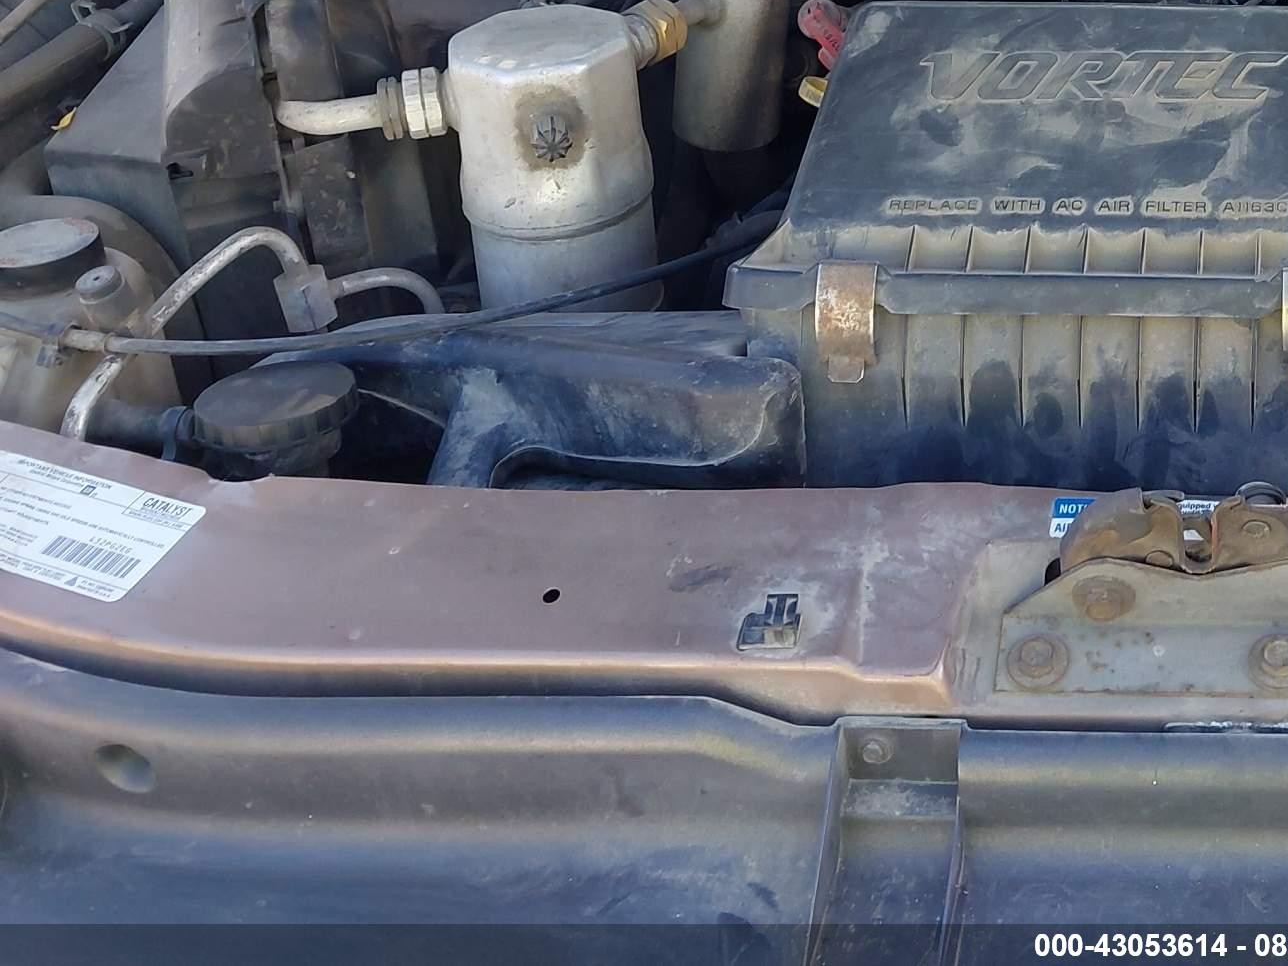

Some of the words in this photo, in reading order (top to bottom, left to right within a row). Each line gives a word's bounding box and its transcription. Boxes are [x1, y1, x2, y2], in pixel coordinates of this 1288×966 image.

[889, 199, 978, 211] REPLACE
[994, 199, 1041, 211] WITH
[1056, 199, 1083, 211] AC
[1097, 200, 1131, 212] AIR
[1145, 200, 1208, 213] FILTER
[143, 497, 193, 520] CATALYST
[1059, 503, 1087, 514] NOT
[1177, 502, 1211, 511] quipped
